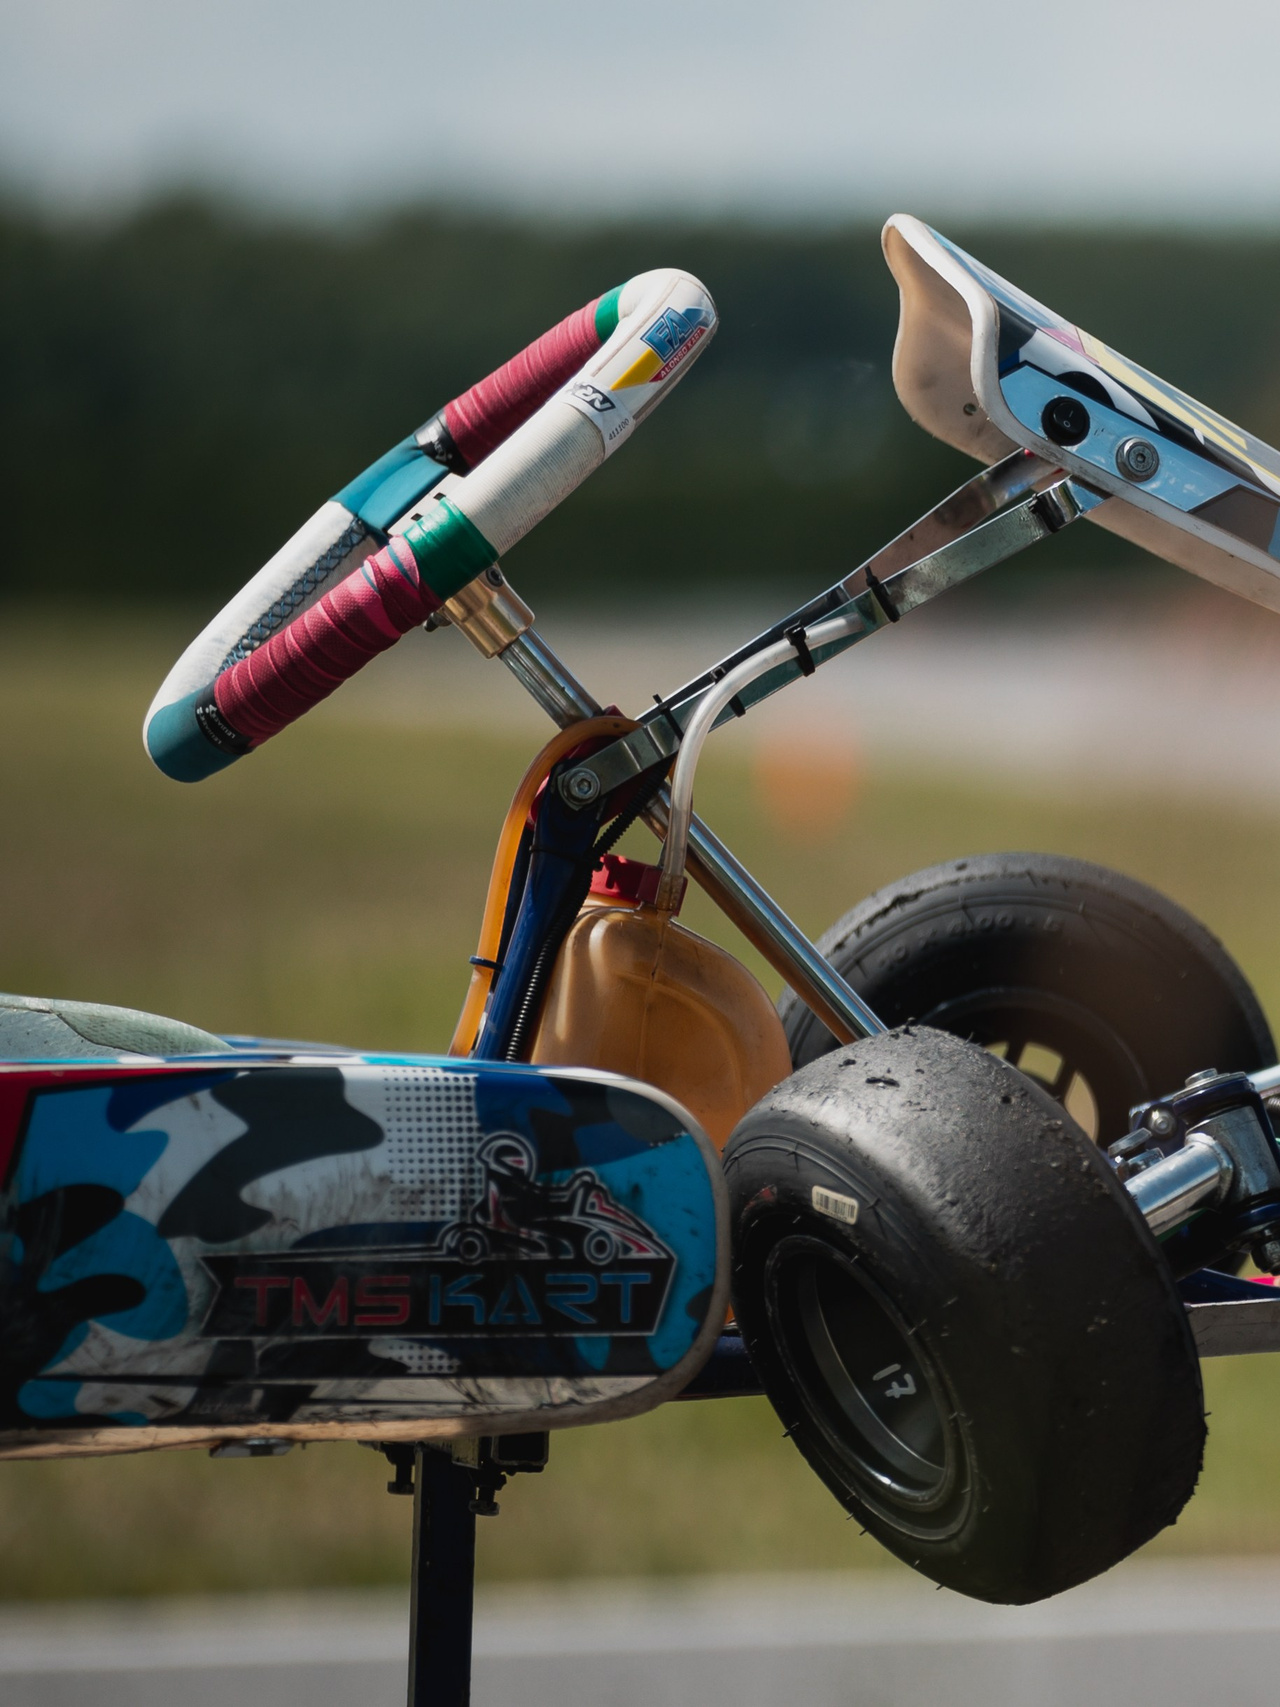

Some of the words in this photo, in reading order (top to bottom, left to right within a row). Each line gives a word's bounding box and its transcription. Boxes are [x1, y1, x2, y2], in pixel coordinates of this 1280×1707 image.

[660, 346, 688, 378] ALONSO
[687, 330, 703, 349] KART
[234, 1275, 411, 1327] TMS
[428, 1273, 652, 1325] KART
[872, 1363, 917, 1399] 17
